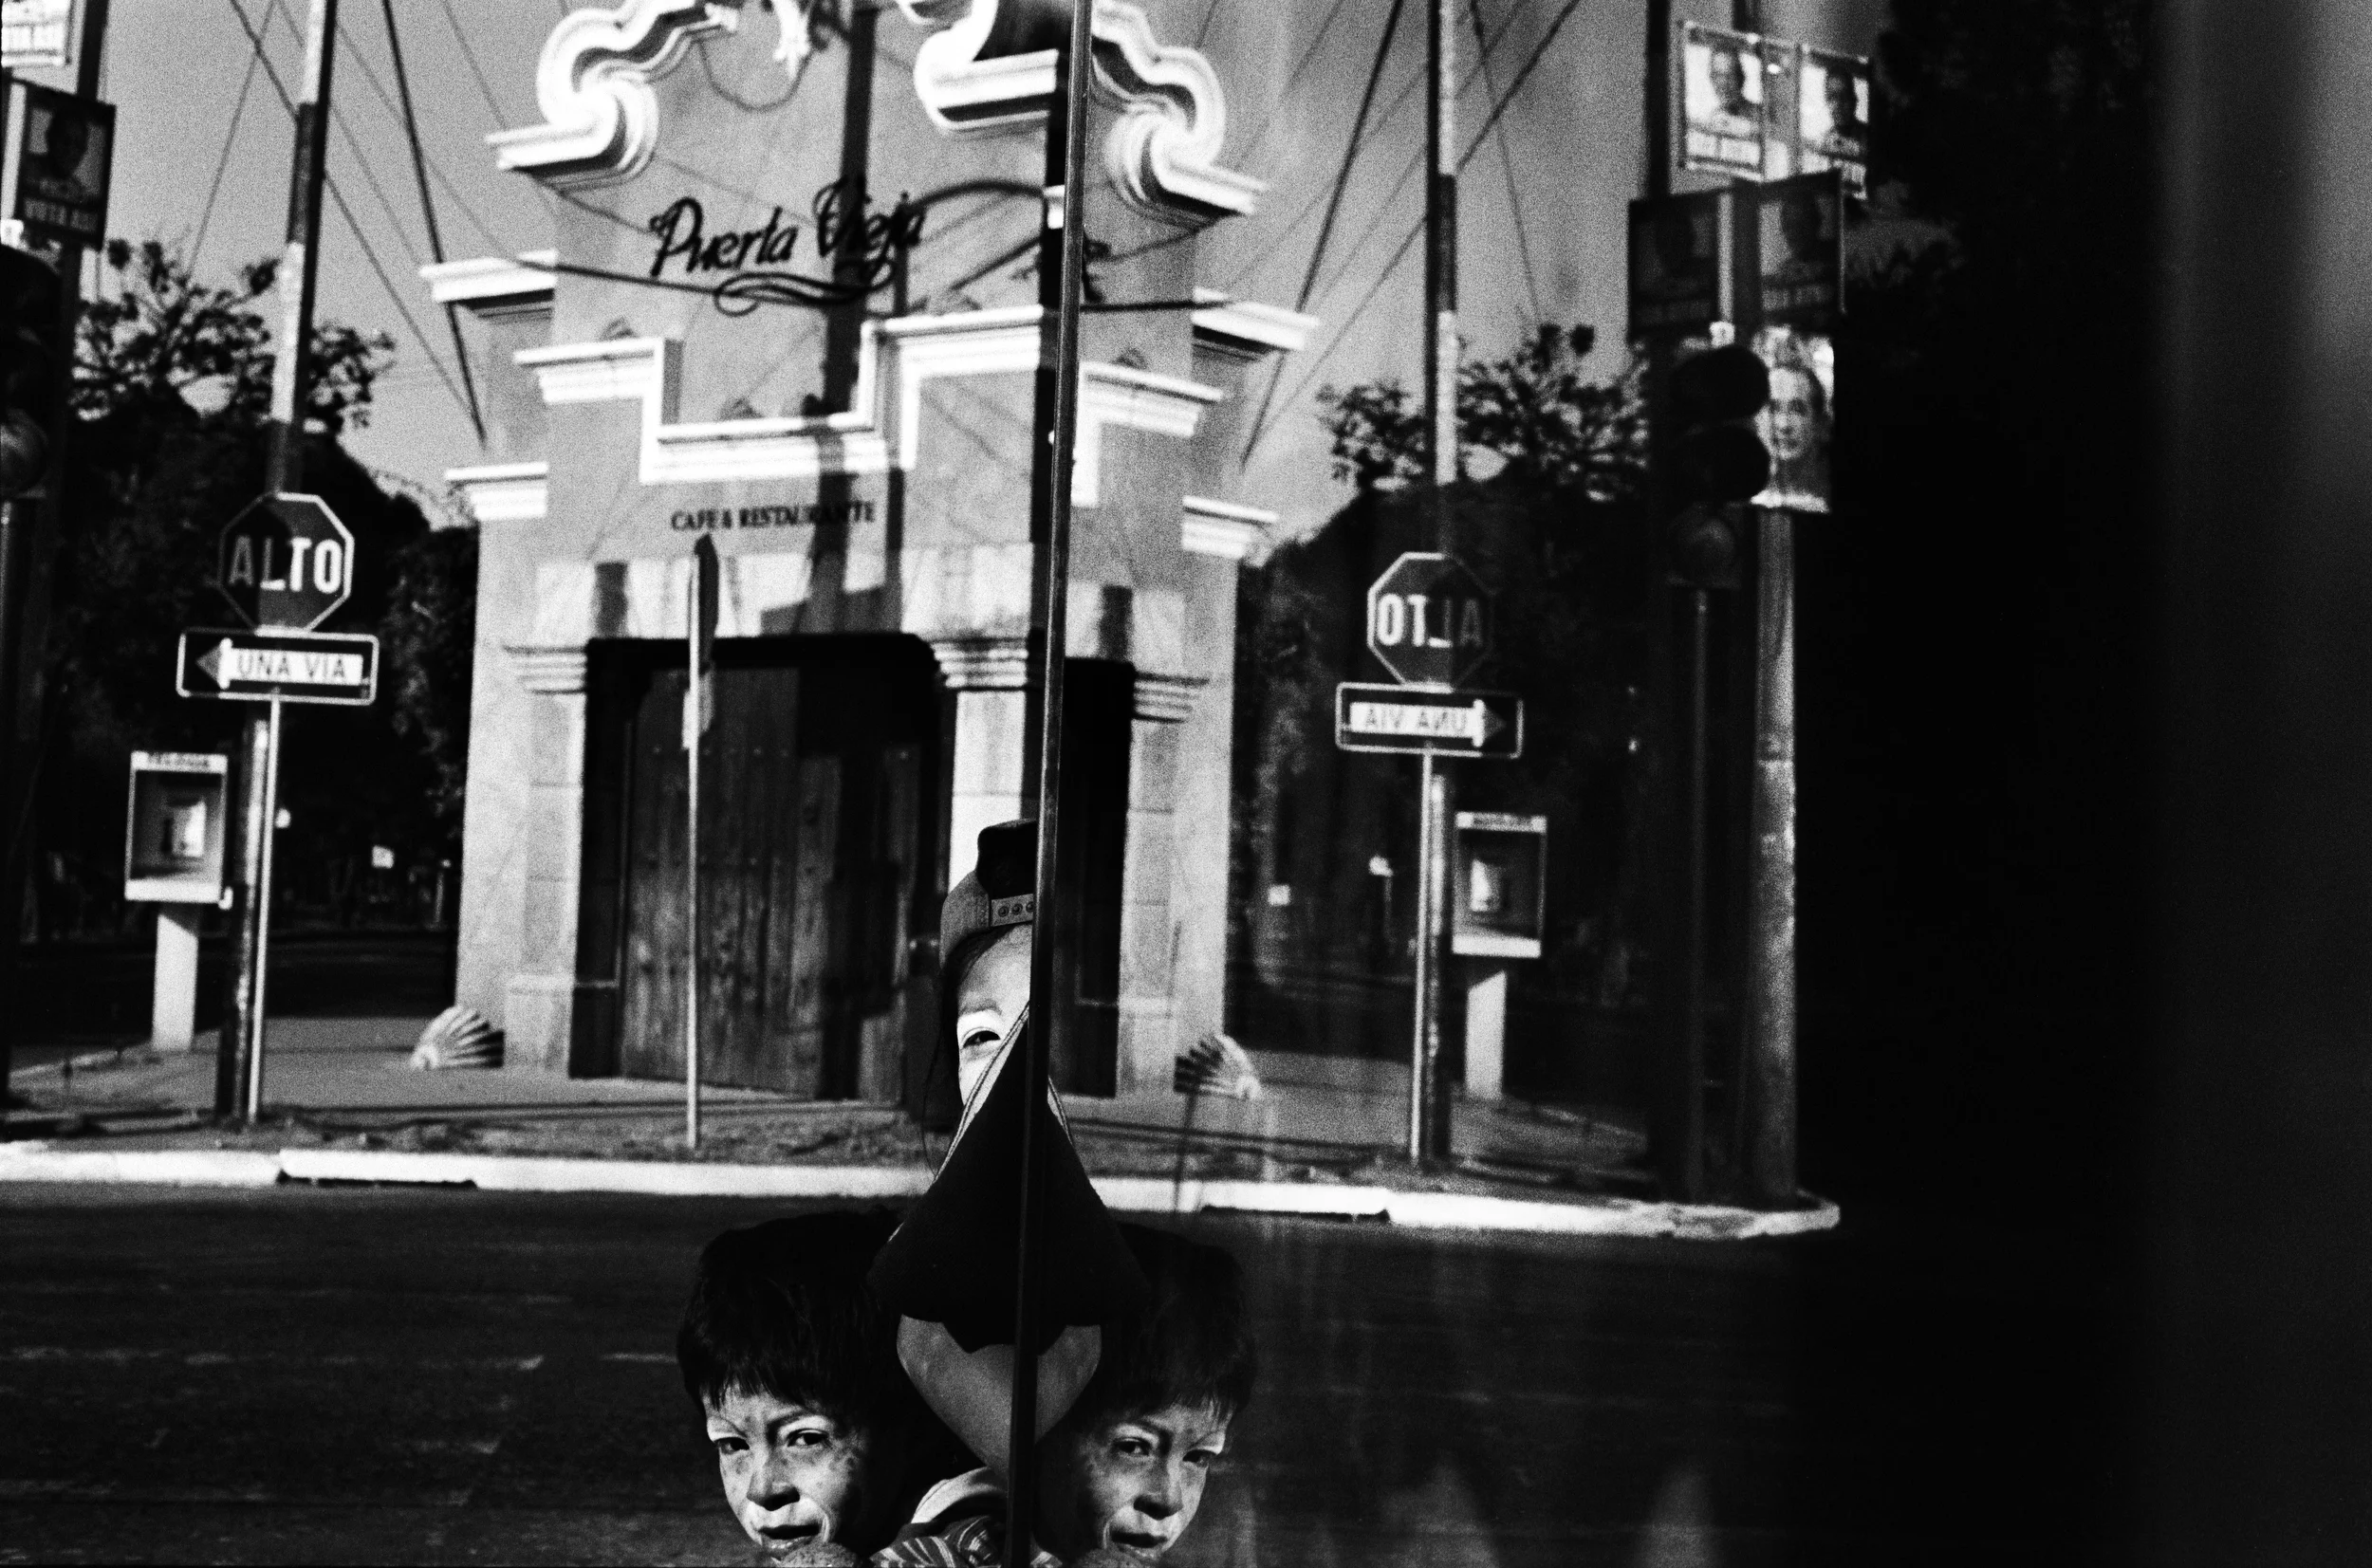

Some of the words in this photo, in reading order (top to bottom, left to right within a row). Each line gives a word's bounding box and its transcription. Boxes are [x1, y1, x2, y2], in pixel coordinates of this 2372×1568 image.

[649, 195, 799, 277] Puerta
[228, 535, 343, 594] ALTO
[237, 651, 290, 679] UNA
[304, 654, 346, 681] VIA
